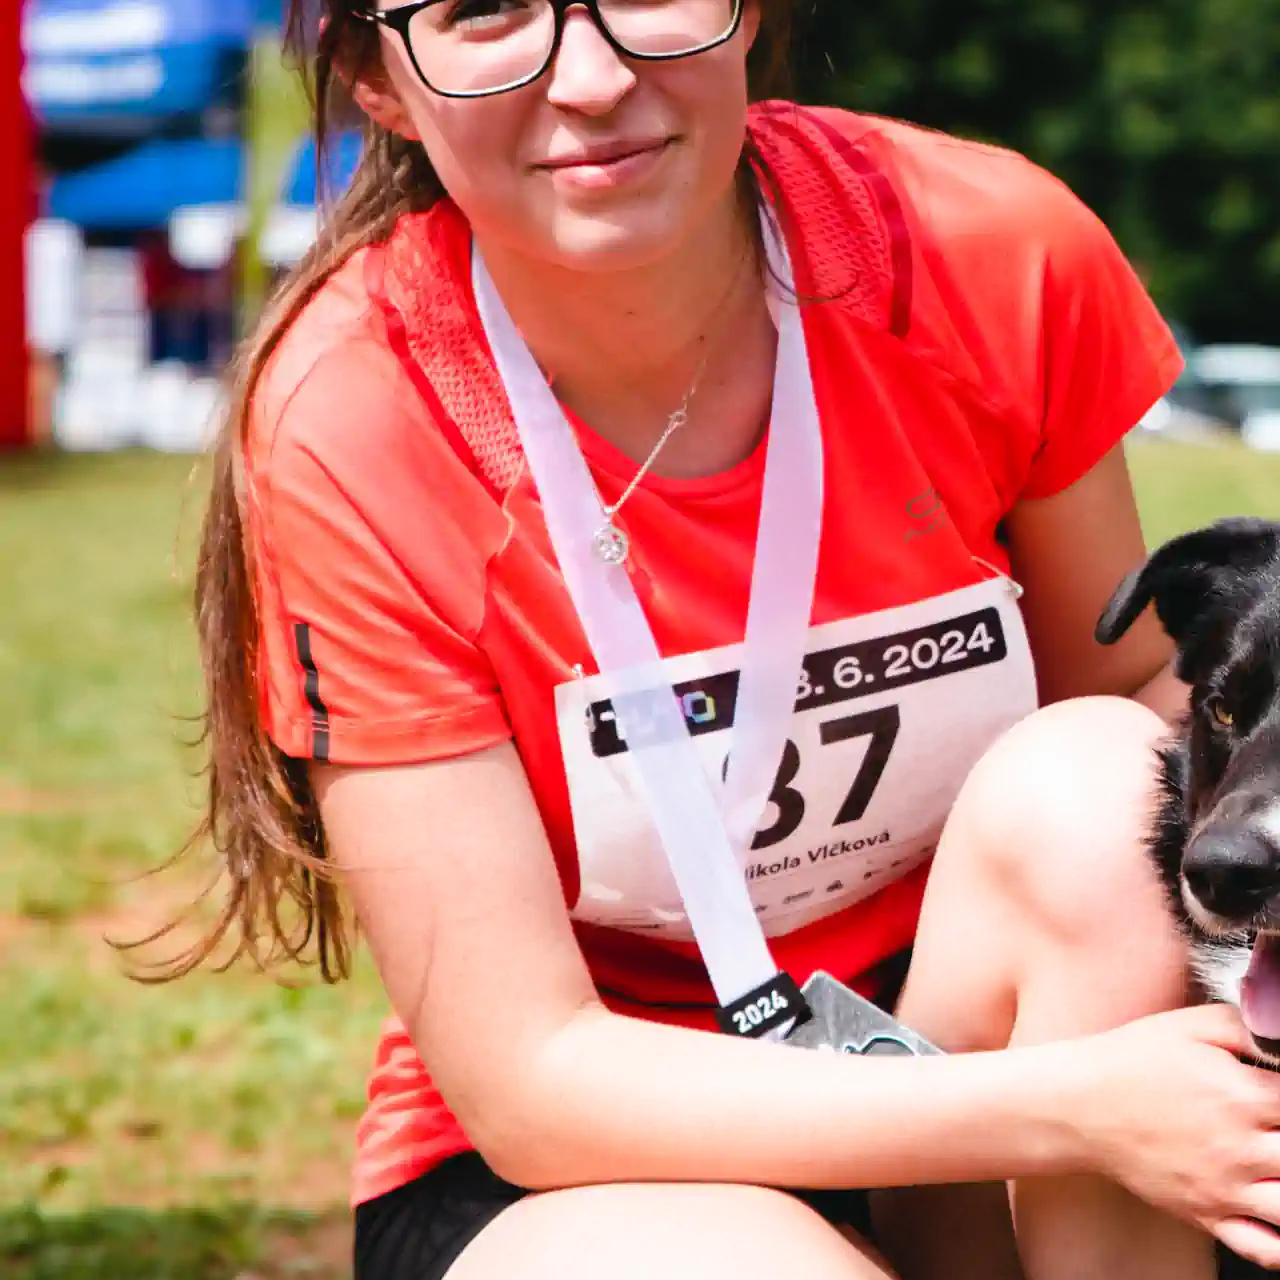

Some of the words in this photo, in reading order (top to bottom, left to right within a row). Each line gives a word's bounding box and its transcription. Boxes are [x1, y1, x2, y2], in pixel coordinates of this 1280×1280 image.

[833, 656, 874, 689] 6.
[882, 622, 996, 678] 2024
[808, 829, 890, 864] Vlčková
[731, 989, 789, 1034] 2024
